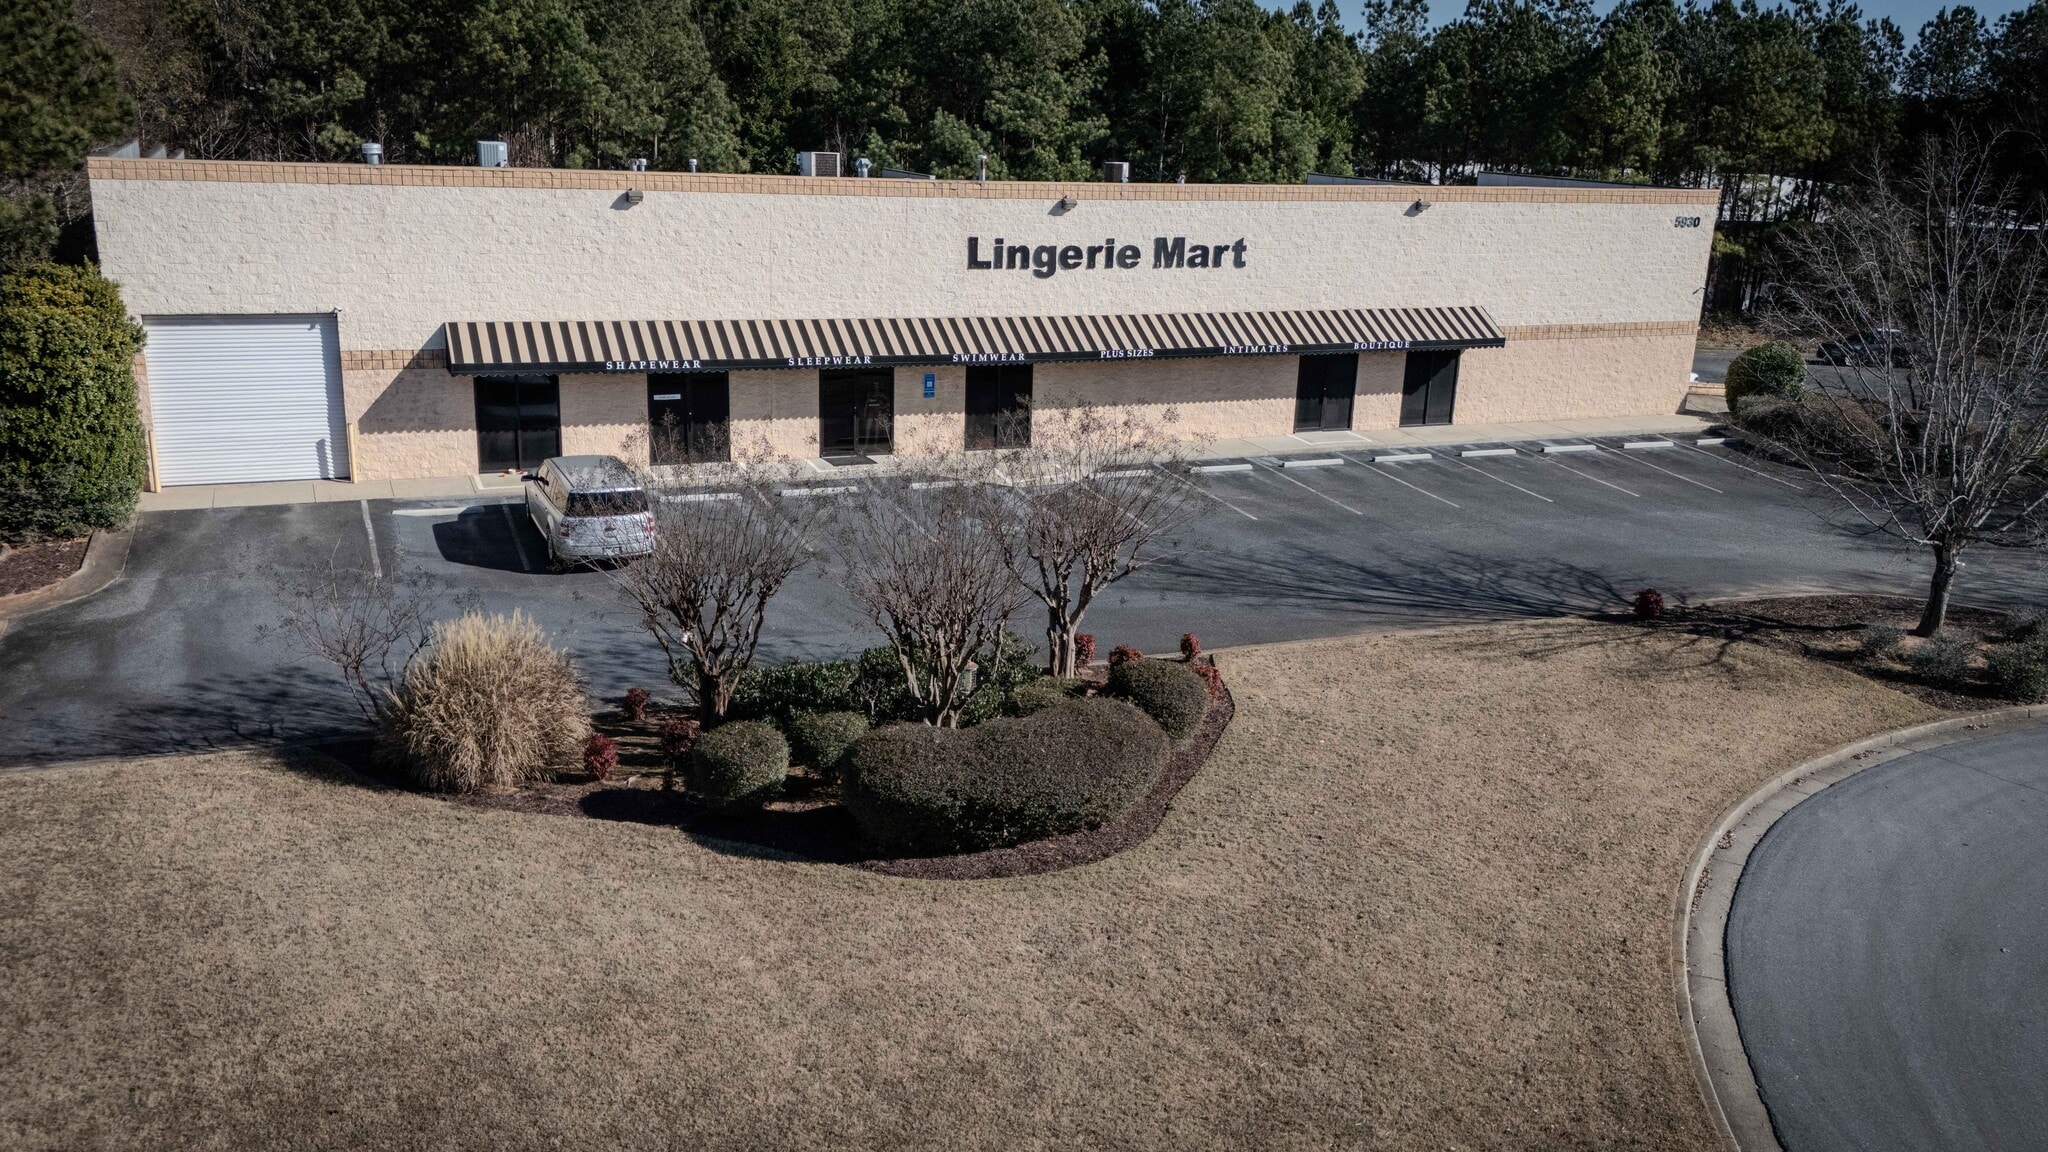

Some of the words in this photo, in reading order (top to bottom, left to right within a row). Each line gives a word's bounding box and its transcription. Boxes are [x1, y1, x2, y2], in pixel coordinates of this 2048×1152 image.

[967, 236, 1141, 279] Lingerie
[1152, 236, 1247, 269] Mart
[1223, 345, 1289, 354] INTIMATES
[1353, 341, 1411, 350] BOUTIQUE
[952, 353, 1025, 362] SWIMWEAR
[1100, 350, 1124, 358] PLUS
[1127, 349, 1154, 357] SIZES
[606, 361, 701, 370] SHAPEWEAR
[788, 356, 871, 366] SLEEPWEAR
